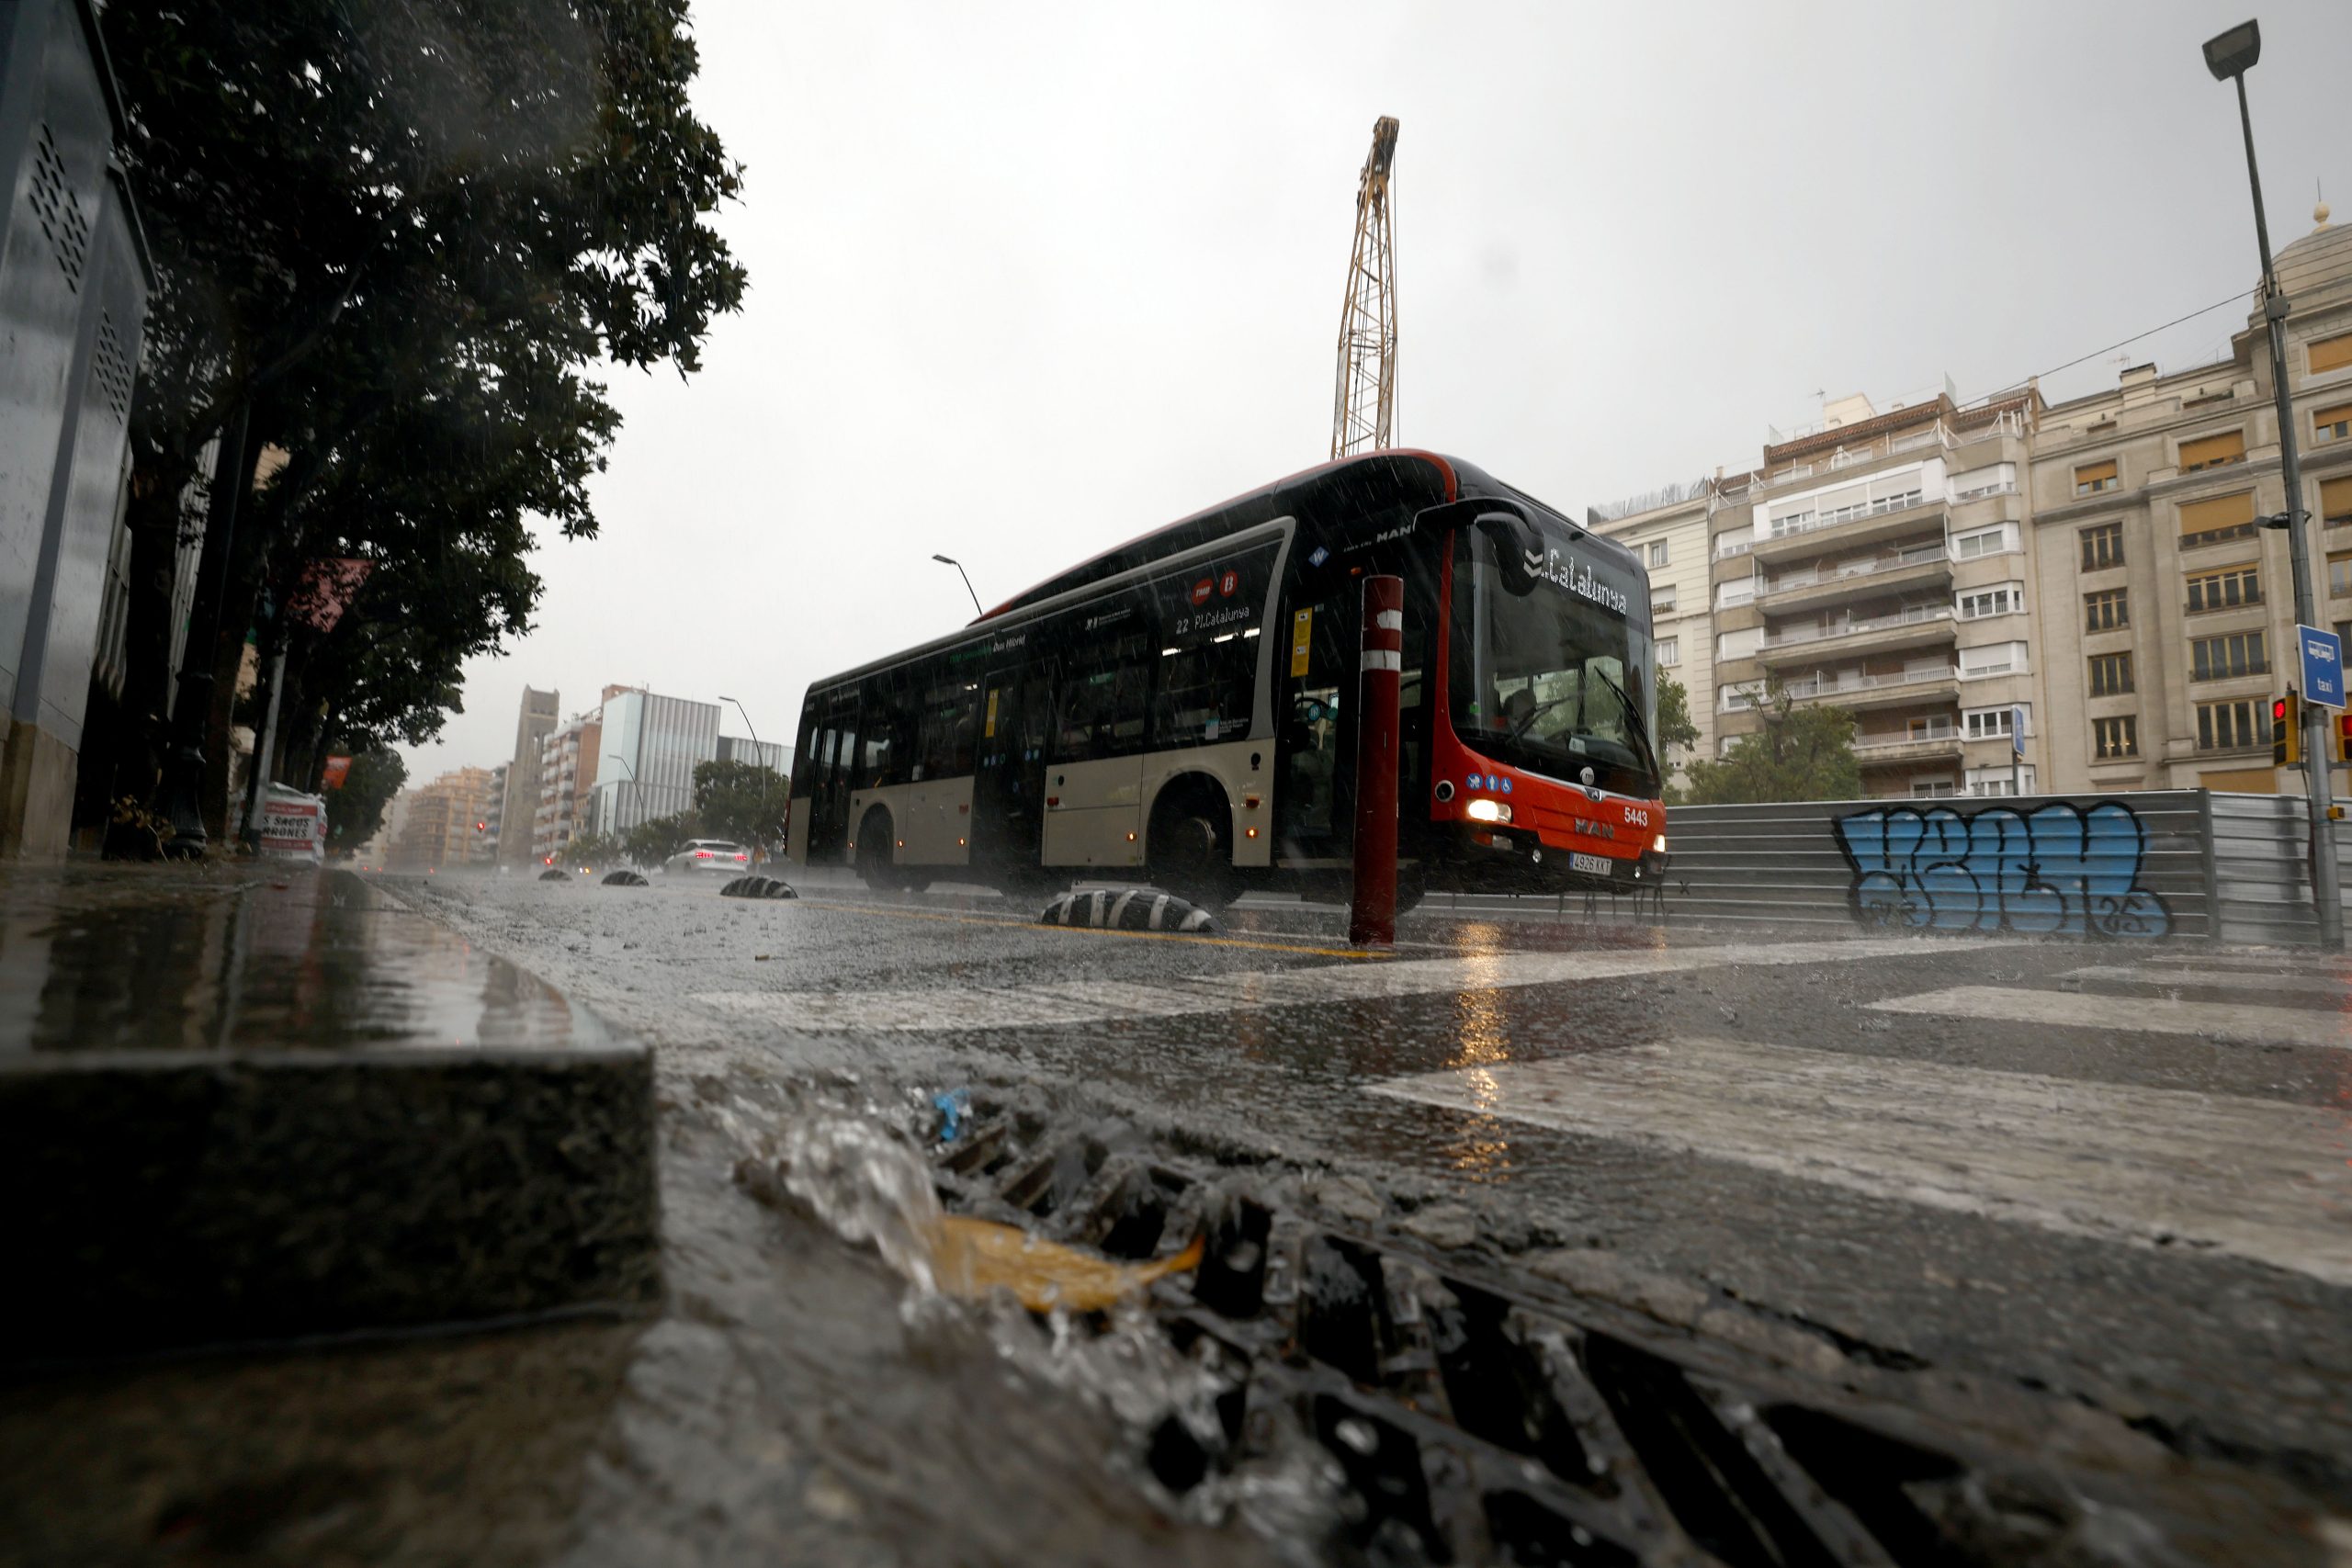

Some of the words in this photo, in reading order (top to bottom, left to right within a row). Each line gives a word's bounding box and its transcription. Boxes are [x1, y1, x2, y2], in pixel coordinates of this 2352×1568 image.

[1376, 525, 1411, 543] MAN
[1541, 547, 1627, 615] .Catalunya
[1195, 586, 1210, 597] TMB
[1176, 618, 1189, 635] 22
[1194, 606, 1250, 630] Pl.Catalunya
[2317, 677, 2334, 694] taxi
[274, 816, 310, 828] SACOS
[1624, 807, 1647, 827] 5443
[1575, 818, 1615, 839] MAN
[1575, 854, 1594, 868] 4926
[1595, 858, 1611, 874] KKT
